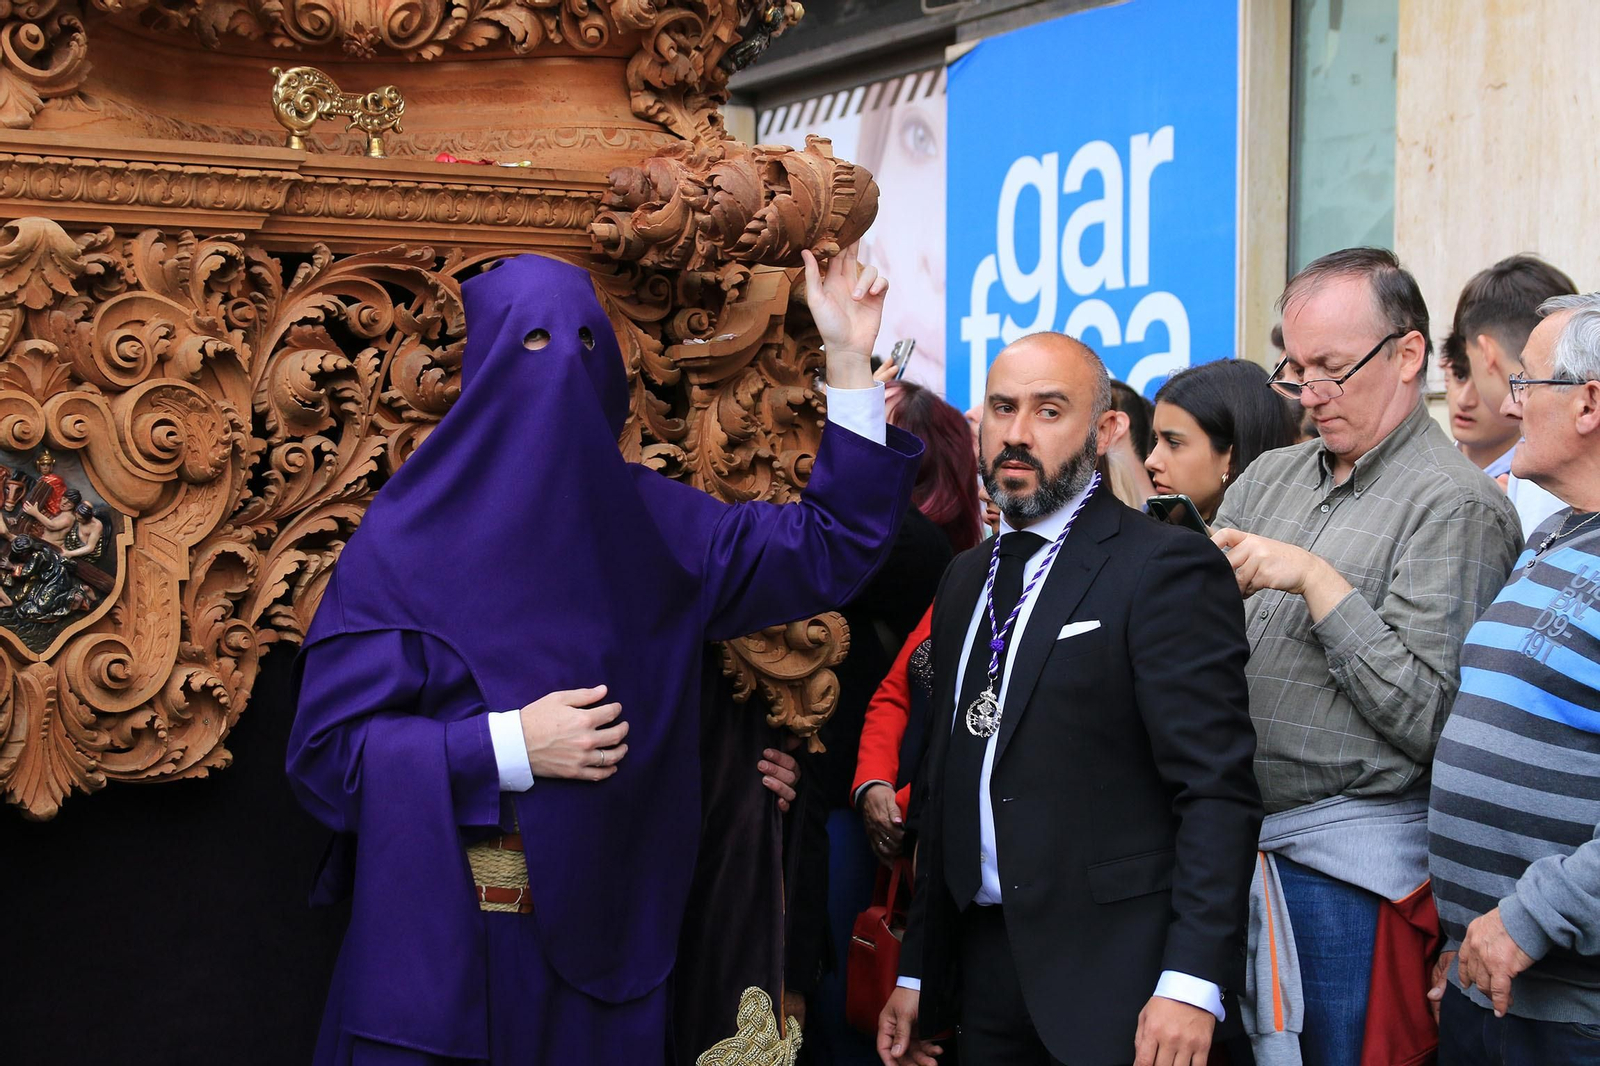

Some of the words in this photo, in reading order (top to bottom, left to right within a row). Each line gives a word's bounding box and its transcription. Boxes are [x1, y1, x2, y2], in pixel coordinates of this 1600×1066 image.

[996, 125, 1174, 344] gar
[960, 253, 1191, 411] fa
[1521, 629, 1562, 665] 19T
[1532, 607, 1573, 637] D9-
